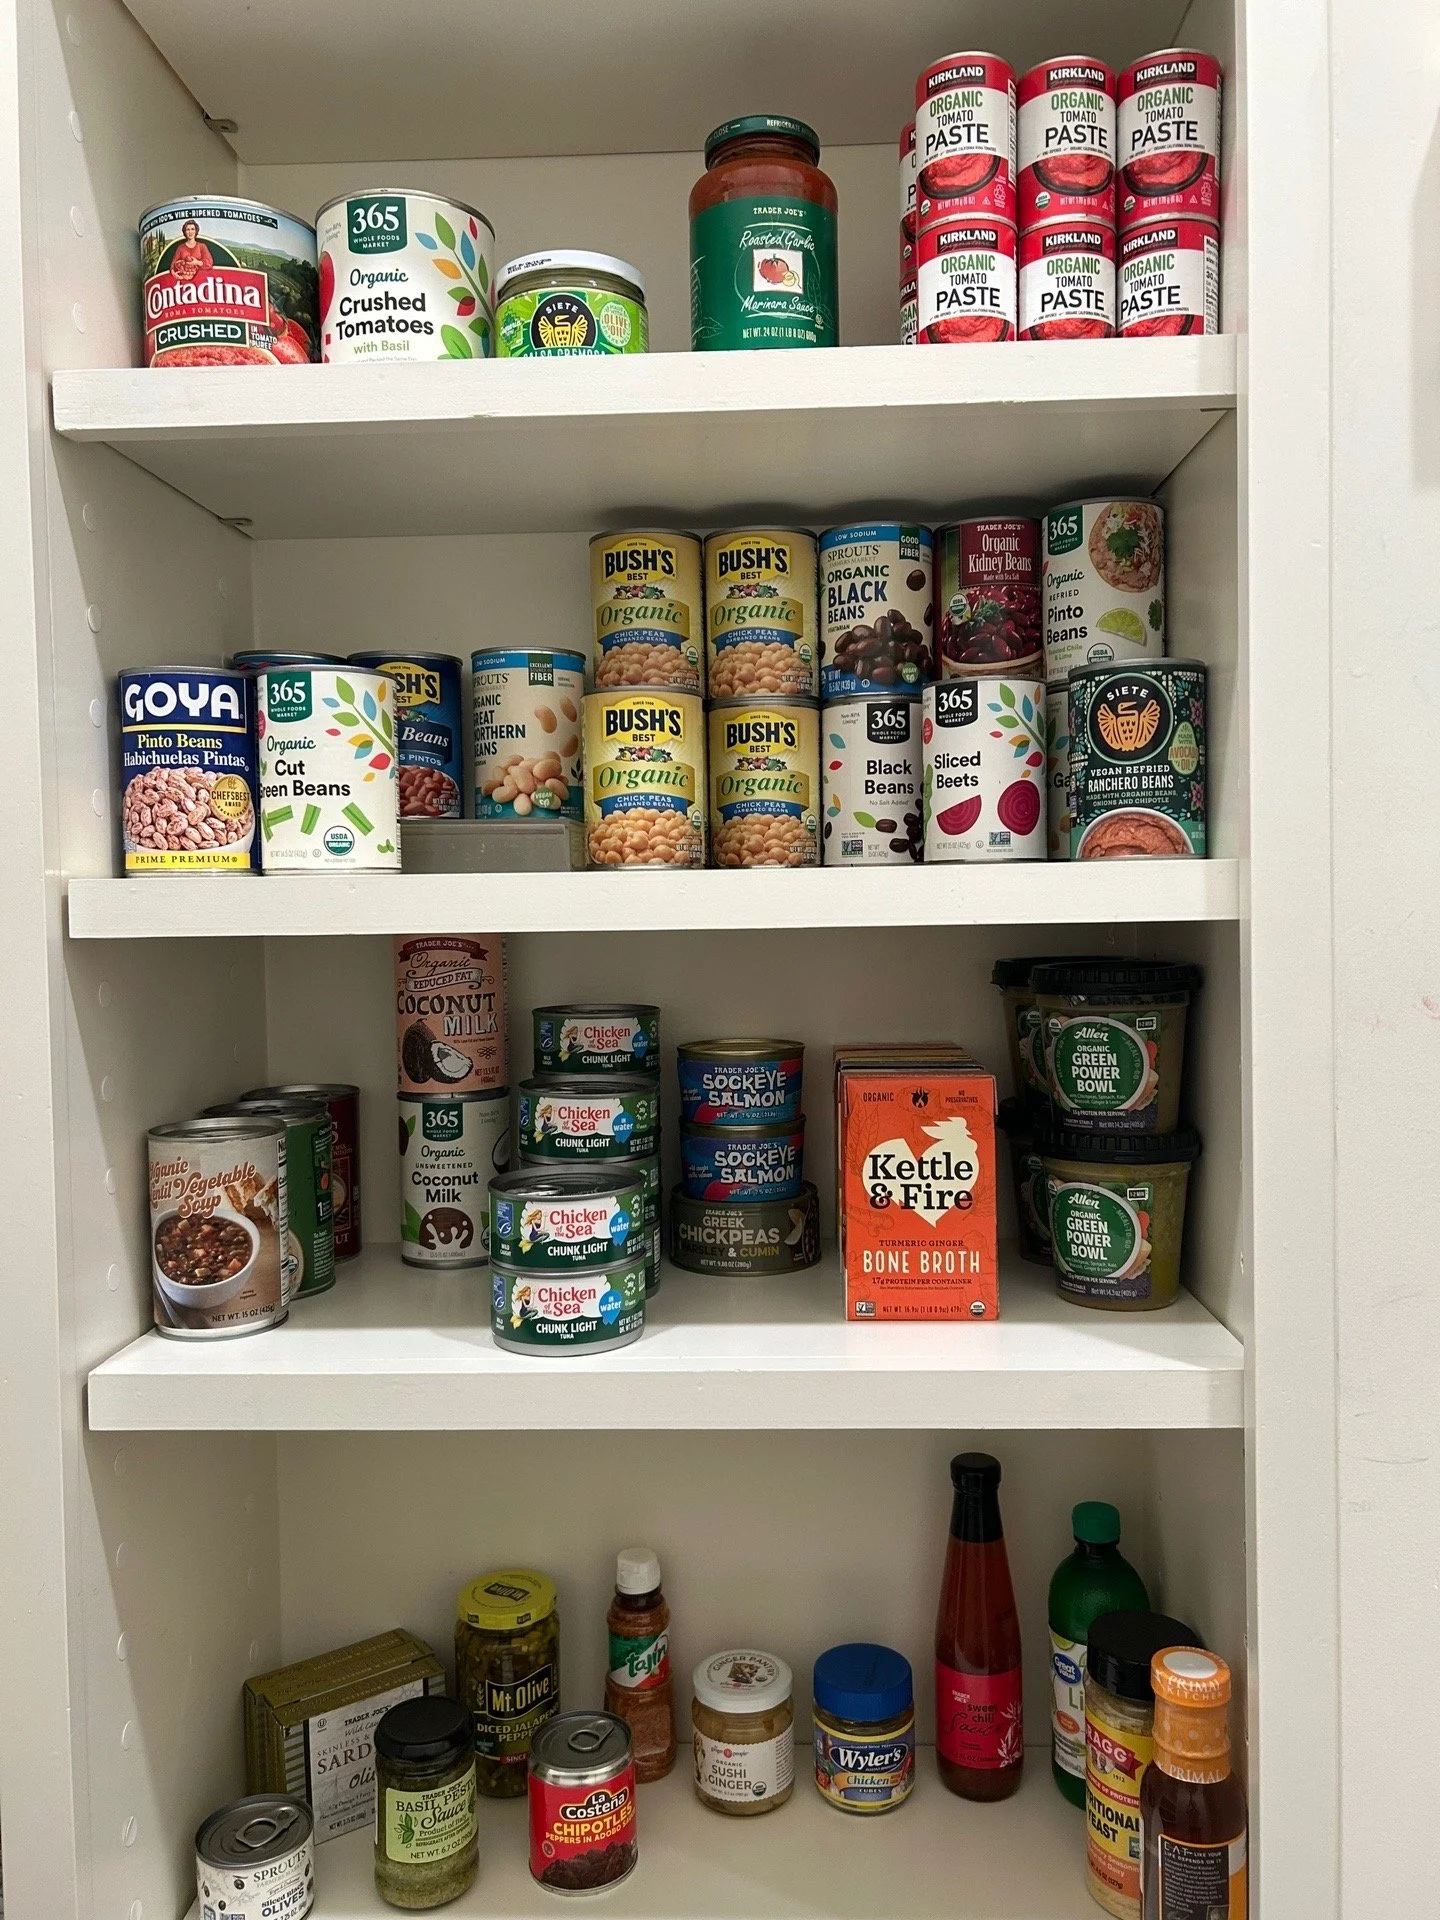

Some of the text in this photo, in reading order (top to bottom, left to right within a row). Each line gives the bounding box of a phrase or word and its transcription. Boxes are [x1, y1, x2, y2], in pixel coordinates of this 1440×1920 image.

[929, 67, 984, 88] KIRKLAND
[1050, 67, 1104, 82] KIRKLAND
[1136, 63, 1195, 82] KIRKLAND
[930, 91, 983, 117] ORGANIC
[1051, 92, 1104, 111] ORGANIC
[1137, 87, 1193, 112] ORGANIC
[937, 110, 973, 128] TOMATO
[1061, 111, 1096, 123] TOMATO
[1145, 106, 1183, 123] TOMATO
[926, 124, 989, 156] PASTE
[1046, 124, 1108, 148] PASTE
[1132, 121, 1198, 151] PASTE
[352, 203, 399, 234] 365
[754, 207, 803, 216] TRADER JOE'S
[940, 230, 996, 246] KIRKLAND
[1123, 230, 1176, 254] KIRKLAND
[941, 254, 995, 274] ORGANIC
[1047, 256, 1100, 276] ORGANIC
[1124, 253, 1175, 283] ORGANIC
[350, 269, 408, 288] Organic
[950, 273, 986, 286] TOMATO
[1130, 274, 1164, 294] TOMATO
[149, 277, 261, 319] Contadina
[339, 291, 426, 316] Crushed
[936, 286, 1000, 311] PASTE
[1042, 289, 1104, 313] PASTE
[1120, 285, 1180, 320] PASTE
[165, 307, 245, 318] ROMA TOMATOES
[158, 324, 241, 344] CRUSHED
[251, 325, 258, 333] IN
[336, 316, 434, 341] Tomatoes
[1050, 515, 1078, 540] 365
[901, 536, 919, 545] GOOD
[982, 533, 1020, 554] Organic
[627, 573, 648, 581] BEST
[740, 572, 762, 580] BEST
[827, 565, 889, 583] ORGANIC
[828, 580, 887, 608] BLACK
[601, 603, 682, 627] Organic
[714, 601, 796, 627] Organic
[828, 605, 864, 624] BEANS
[1048, 605, 1084, 624] Pinto
[615, 630, 640, 638] CHICK
[728, 630, 753, 638] CHICK
[1047, 626, 1088, 645] Beans
[270, 679, 305, 705] 365
[938, 687, 973, 713] 365
[125, 682, 239, 722] GOYA
[606, 708, 680, 737] BUSH'S
[871, 708, 906, 729] 365
[137, 733, 222, 749] Pinto Beans
[267, 736, 316, 756] Organic
[632, 734, 655, 742] BEST
[749, 745, 771, 753] BEST
[124, 751, 245, 767] Habichuelas Pintas
[275, 760, 305, 776] Cut
[866, 759, 912, 775] Black
[934, 751, 981, 770] Sliced
[600, 766, 688, 788] Organic
[936, 772, 979, 789] Beets
[1091, 765, 1170, 777] VEGAN REFRIED
[721, 774, 802, 796] Organic
[864, 780, 914, 795] Beans
[1088, 775, 1174, 793] RANCHERO BEANS
[617, 795, 645, 803] CHICK
[397, 990, 495, 1016] COCONUT
[443, 1012, 498, 1036] MILK
[582, 1054, 631, 1064] CHUNK LIGHT
[1072, 1053, 1117, 1066] GREEN
[703, 1070, 786, 1093] SOCKEYE
[1072, 1067, 1120, 1079] POWER
[1077, 1079, 1116, 1092] BOWL
[708, 1090, 785, 1108] SALMON
[426, 1109, 458, 1128] 365
[613, 1122, 633, 1131] water
[555, 1138, 610, 1147] CHUNK LIGHT
[421, 1145, 465, 1161] Organic
[715, 1146, 796, 1169] SOCKEYE
[721, 1164, 794, 1185] SALMON
[868, 1152, 973, 1180] Kettle
[412, 1171, 479, 1185] Coconut
[426, 1189, 462, 1202] Milk
[870, 1182, 973, 1210] & Fire
[178, 1195, 221, 1219] Soup
[703, 1216, 744, 1228] GREEK
[1067, 1218, 1108, 1233] GREEN
[679, 1223, 780, 1244] CHICKPEAS
[1067, 1230, 1112, 1247] POWER
[548, 1242, 608, 1257] CHUNK LIGHT
[1071, 1245, 1108, 1261] BOWL
[863, 1250, 980, 1273] BONE BROTH
[536, 1321, 597, 1334] CHUNK LIGHT
[713, 1655, 774, 1677] GINGER PANTRY
[1054, 1657, 1075, 1675] Great
[492, 1677, 549, 1712] Mt. Olive
[967, 1703, 997, 1713] sweet
[972, 1713, 994, 1723] chili
[716, 1759, 742, 1767] ORGANIC
[839, 1747, 901, 1770] Wyler's
[711, 1764, 746, 1778] SUSHI
[847, 1775, 889, 1786] Chicken
[1169, 1765, 1224, 1783] PRIMAL
[708, 1774, 752, 1790] GINGER
[395, 1800, 440, 1813] BASIL
[443, 1774, 476, 1806] PESTO
[591, 1793, 606, 1805] La
[1101, 1785, 1139, 1805] OF PROTEIN
[421, 1799, 466, 1830] Sauce
[566, 1794, 625, 1819] Costeña
[553, 1800, 633, 1837] CHIPOTLES
[1088, 1813, 1118, 1842] YEAST
[1164, 1841, 1188, 1856] EAT
[253, 1849, 306, 1883] SPROUTS
[262, 1882, 304, 1907] Sliced Black
[262, 1888, 305, 1917] OLIVES
